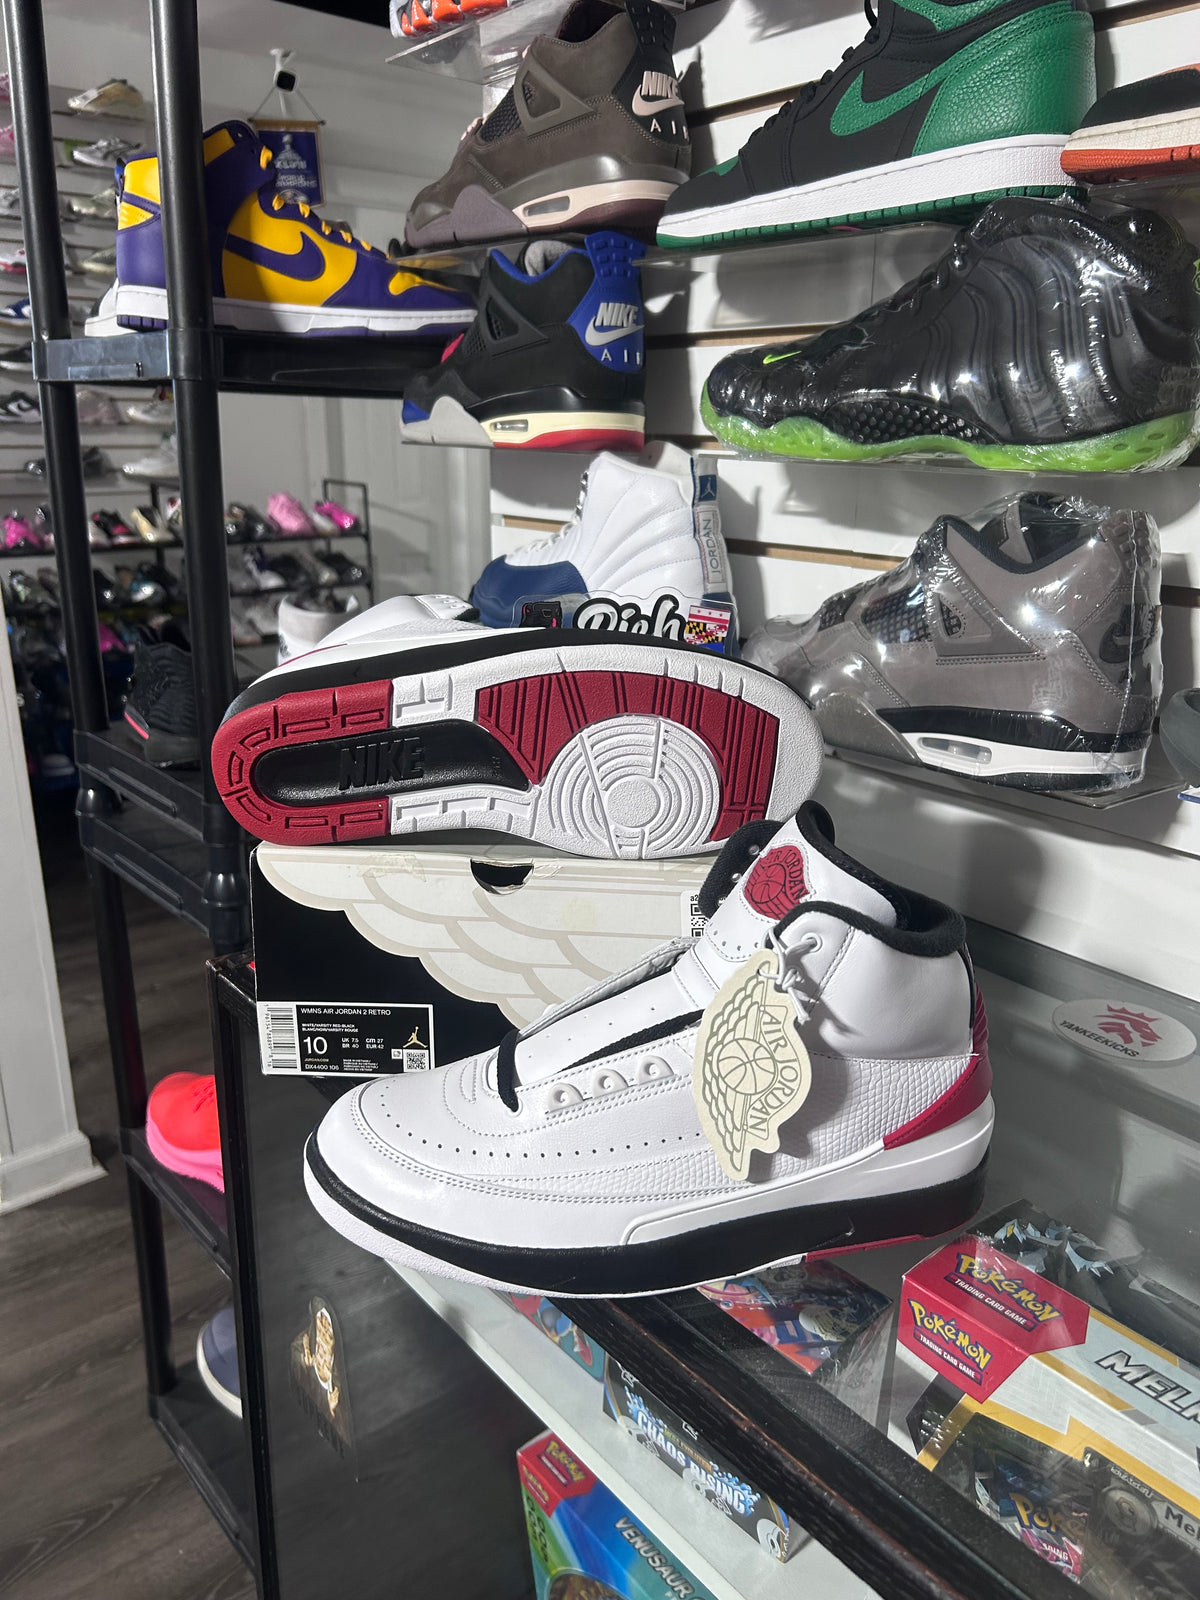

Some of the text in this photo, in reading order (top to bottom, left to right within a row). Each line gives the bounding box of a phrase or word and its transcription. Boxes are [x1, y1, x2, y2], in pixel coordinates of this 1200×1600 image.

[641, 71, 679, 99] NIKE
[595, 302, 639, 328] NIKE
[702, 518, 722, 574] JORDAN
[338, 737, 425, 791] NIKE
[780, 849, 810, 901] JORDAN
[301, 1007, 322, 1015] WMNS
[335, 1008, 362, 1016] JORDAN
[762, 1011, 788, 1053] AIR
[303, 1036, 328, 1055] 10
[1060, 1020, 1140, 1058] YANKEEKICKS
[750, 1058, 799, 1133] JORDAN
[954, 1278, 1028, 1326] TRADING CARD GAME
[957, 1252, 1064, 1324] Pokémon
[908, 1299, 993, 1372] Pokémon
[919, 1333, 976, 1379] TRADING CARD GAME
[636, 1409, 686, 1468] CHAOS
[688, 1458, 748, 1515] RISING
[614, 1514, 696, 1600] VENUSAUR
